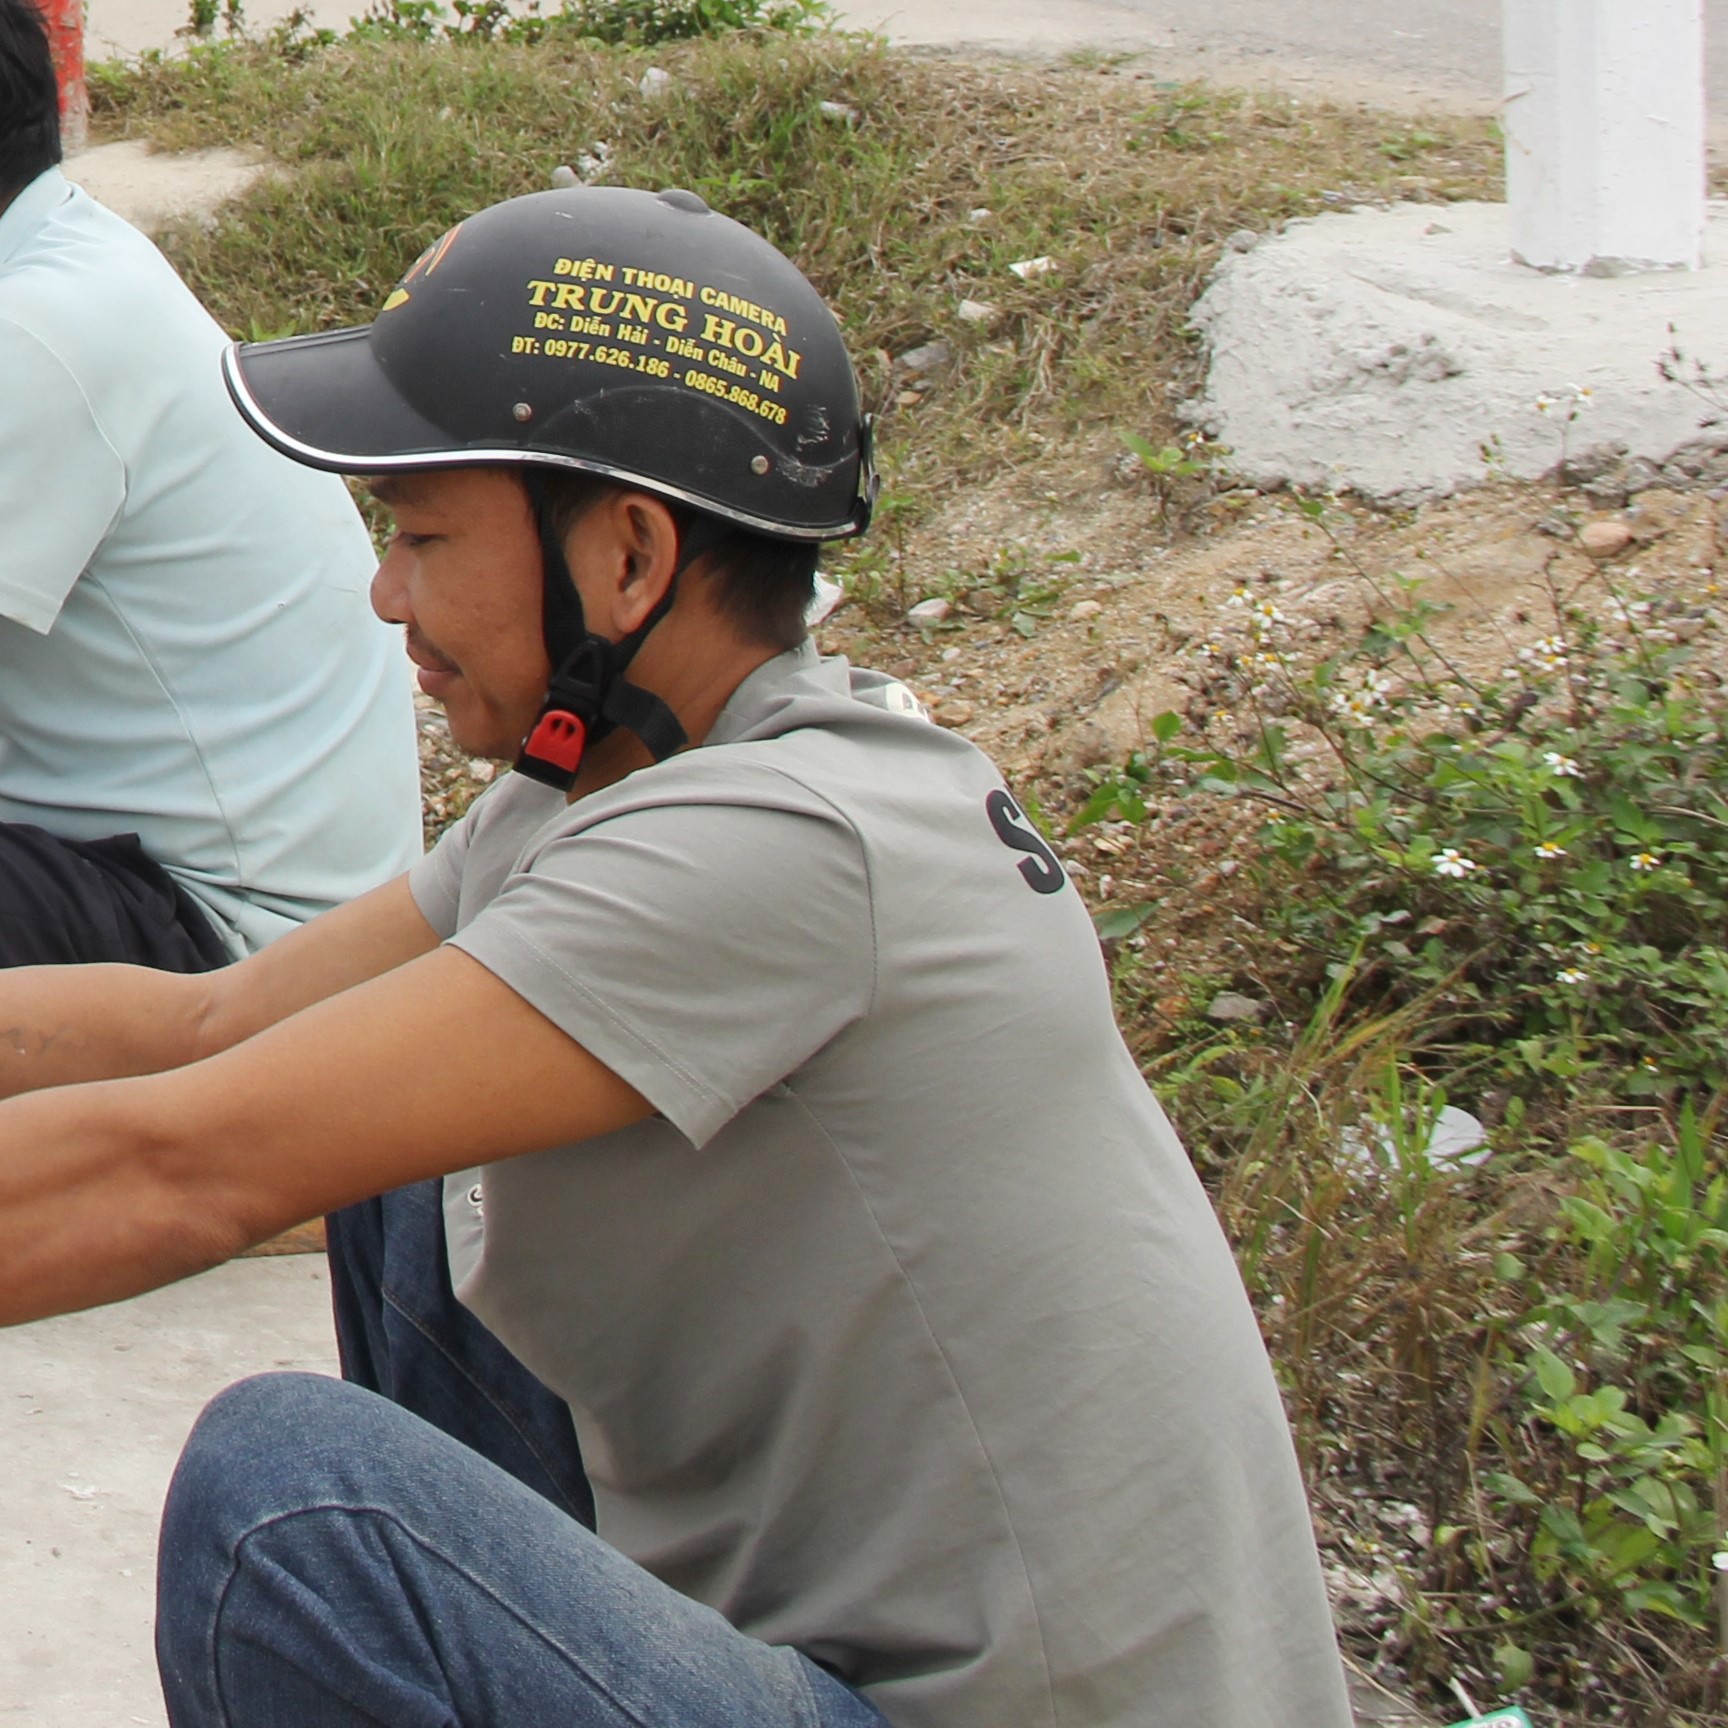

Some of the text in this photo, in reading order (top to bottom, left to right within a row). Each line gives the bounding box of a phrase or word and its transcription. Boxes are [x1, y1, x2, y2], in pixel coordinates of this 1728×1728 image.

[527, 280, 802, 380] TRUNG HOÀI
[553, 257, 788, 337] ĐIỆN THOẠI CAMERA
[511, 335, 541, 355] ĐT:
[544, 338, 670, 378] 0977.626.186
[684, 369, 788, 425] 0865.868.678
[534, 311, 565, 331] ĐC:
[570, 315, 611, 337] Diễn
[616, 323, 649, 345] Hải
[665, 335, 704, 361] Diễn
[708, 348, 747, 378] Châu
[759, 369, 780, 393] NA
